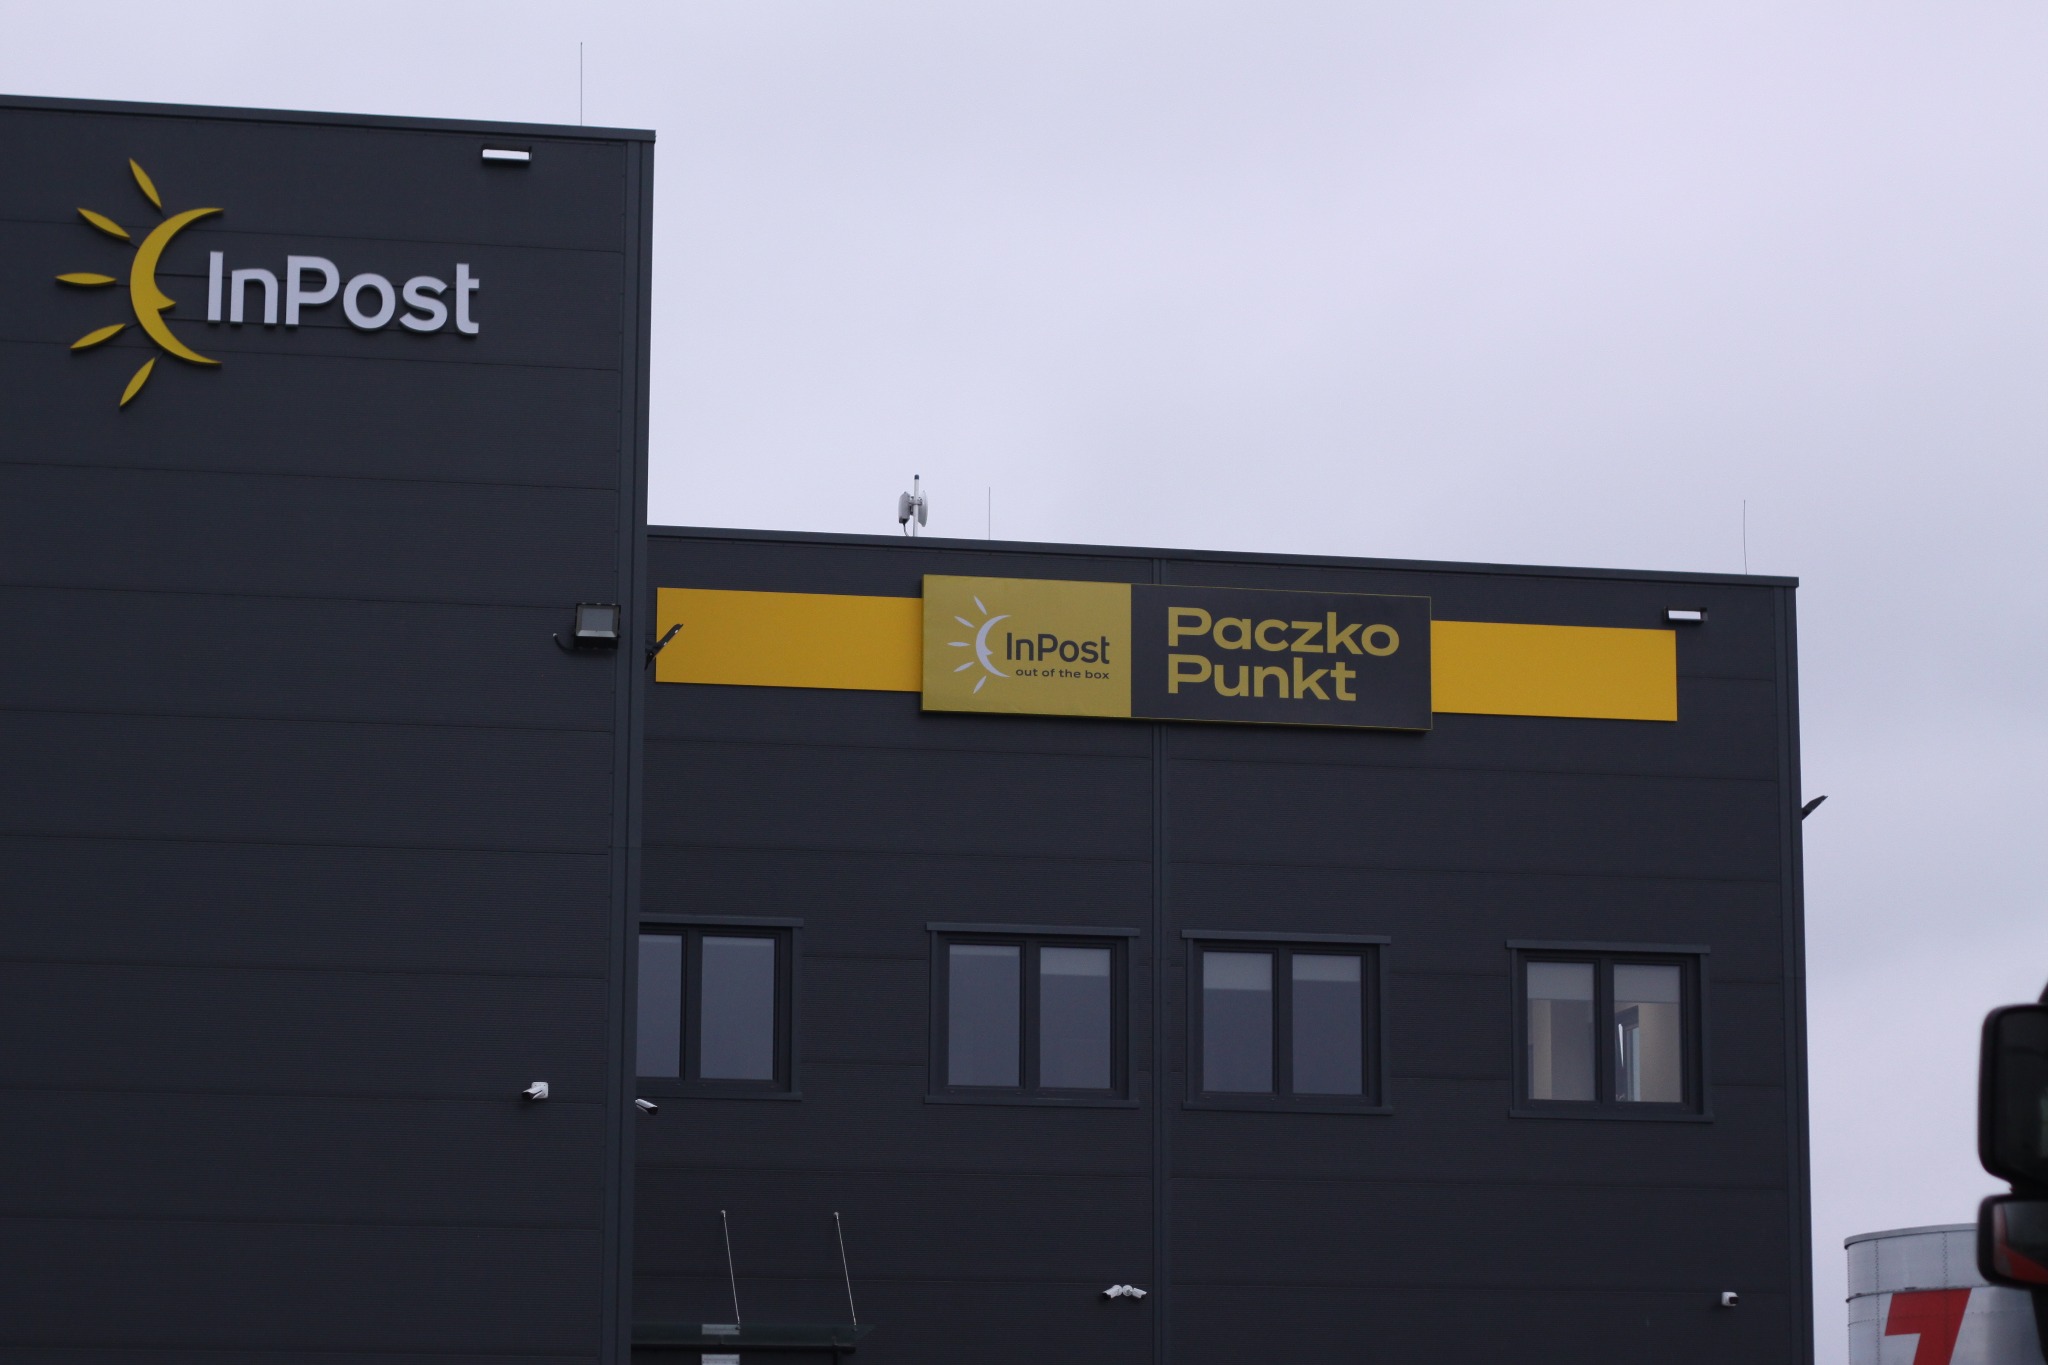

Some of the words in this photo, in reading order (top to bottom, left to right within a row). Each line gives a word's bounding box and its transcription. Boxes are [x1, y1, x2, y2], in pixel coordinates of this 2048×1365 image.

[207, 251, 480, 336] InPost
[1006, 632, 1110, 664] InPost
[1167, 606, 1400, 657] Paczko
[1015, 668, 1038, 677] out
[1041, 668, 1056, 678] of
[1058, 668, 1081, 679] the
[1085, 670, 1110, 680] box
[1167, 653, 1357, 702] Punkt
